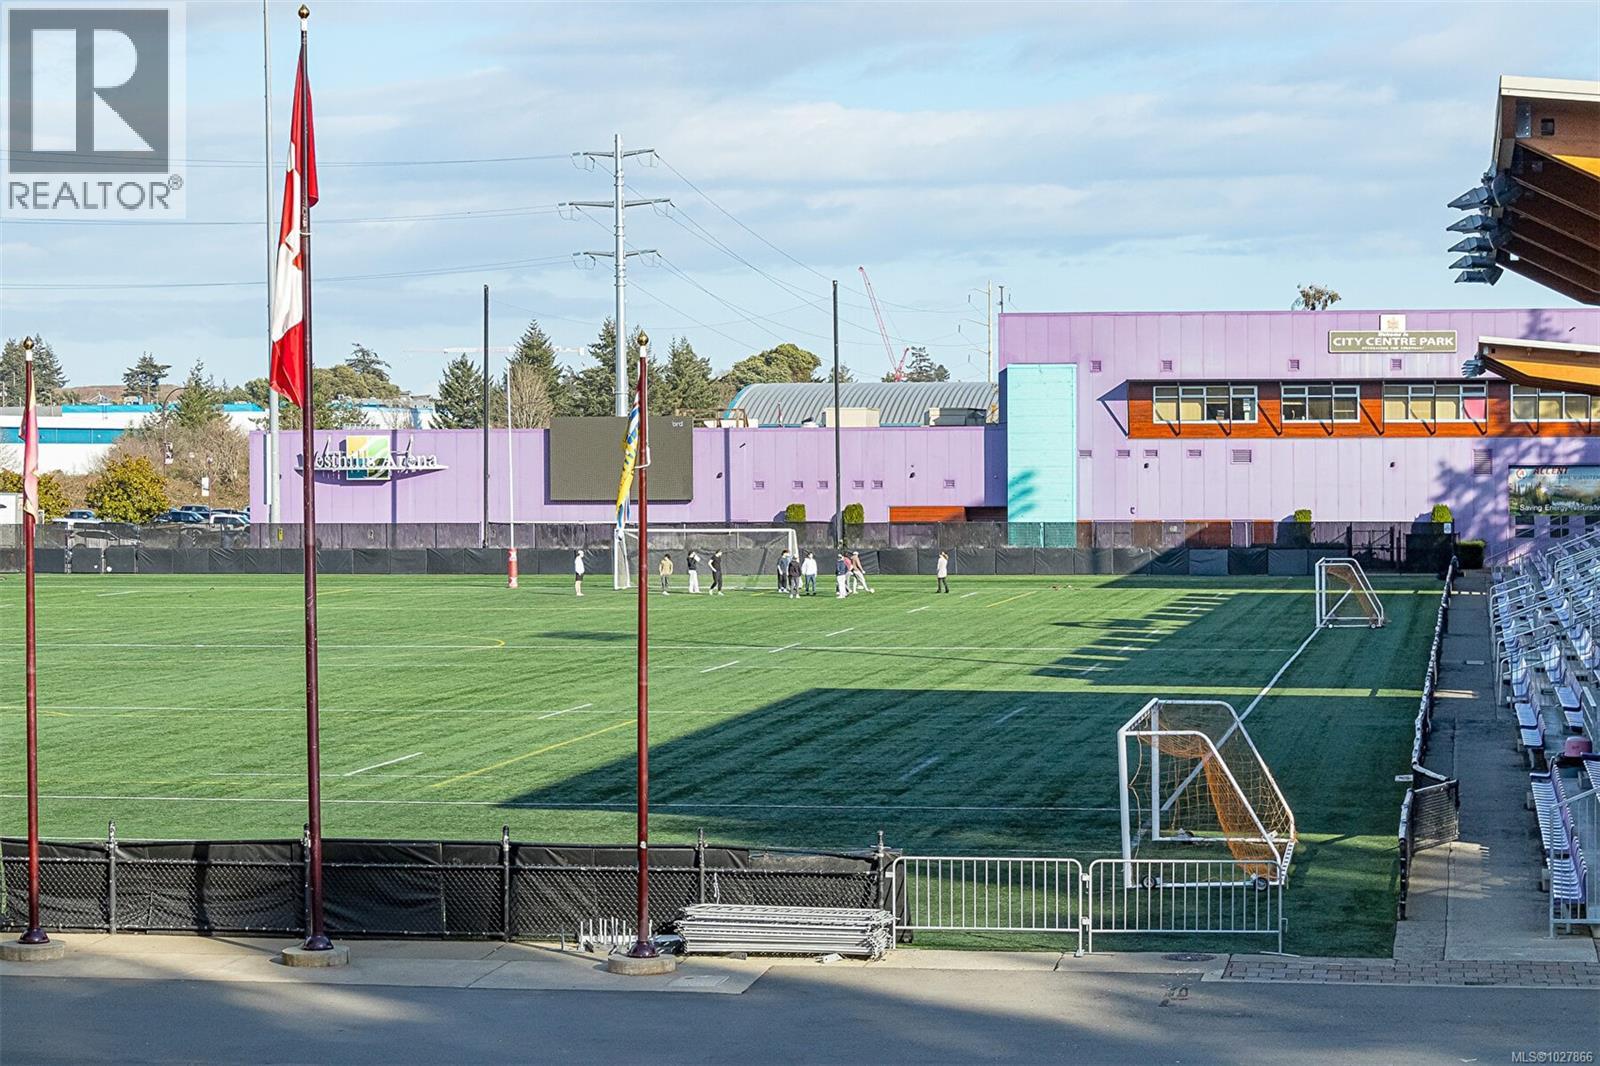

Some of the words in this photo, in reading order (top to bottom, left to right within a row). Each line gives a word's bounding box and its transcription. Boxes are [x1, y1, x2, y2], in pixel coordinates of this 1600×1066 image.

[1333, 337, 1363, 346] CITY
[1365, 337, 1419, 346] CENTRE
[1419, 337, 1454, 346] PARK
[313, 450, 376, 468] esthills
[381, 451, 438, 468] Arena
[1520, 503, 1543, 512] Saving
